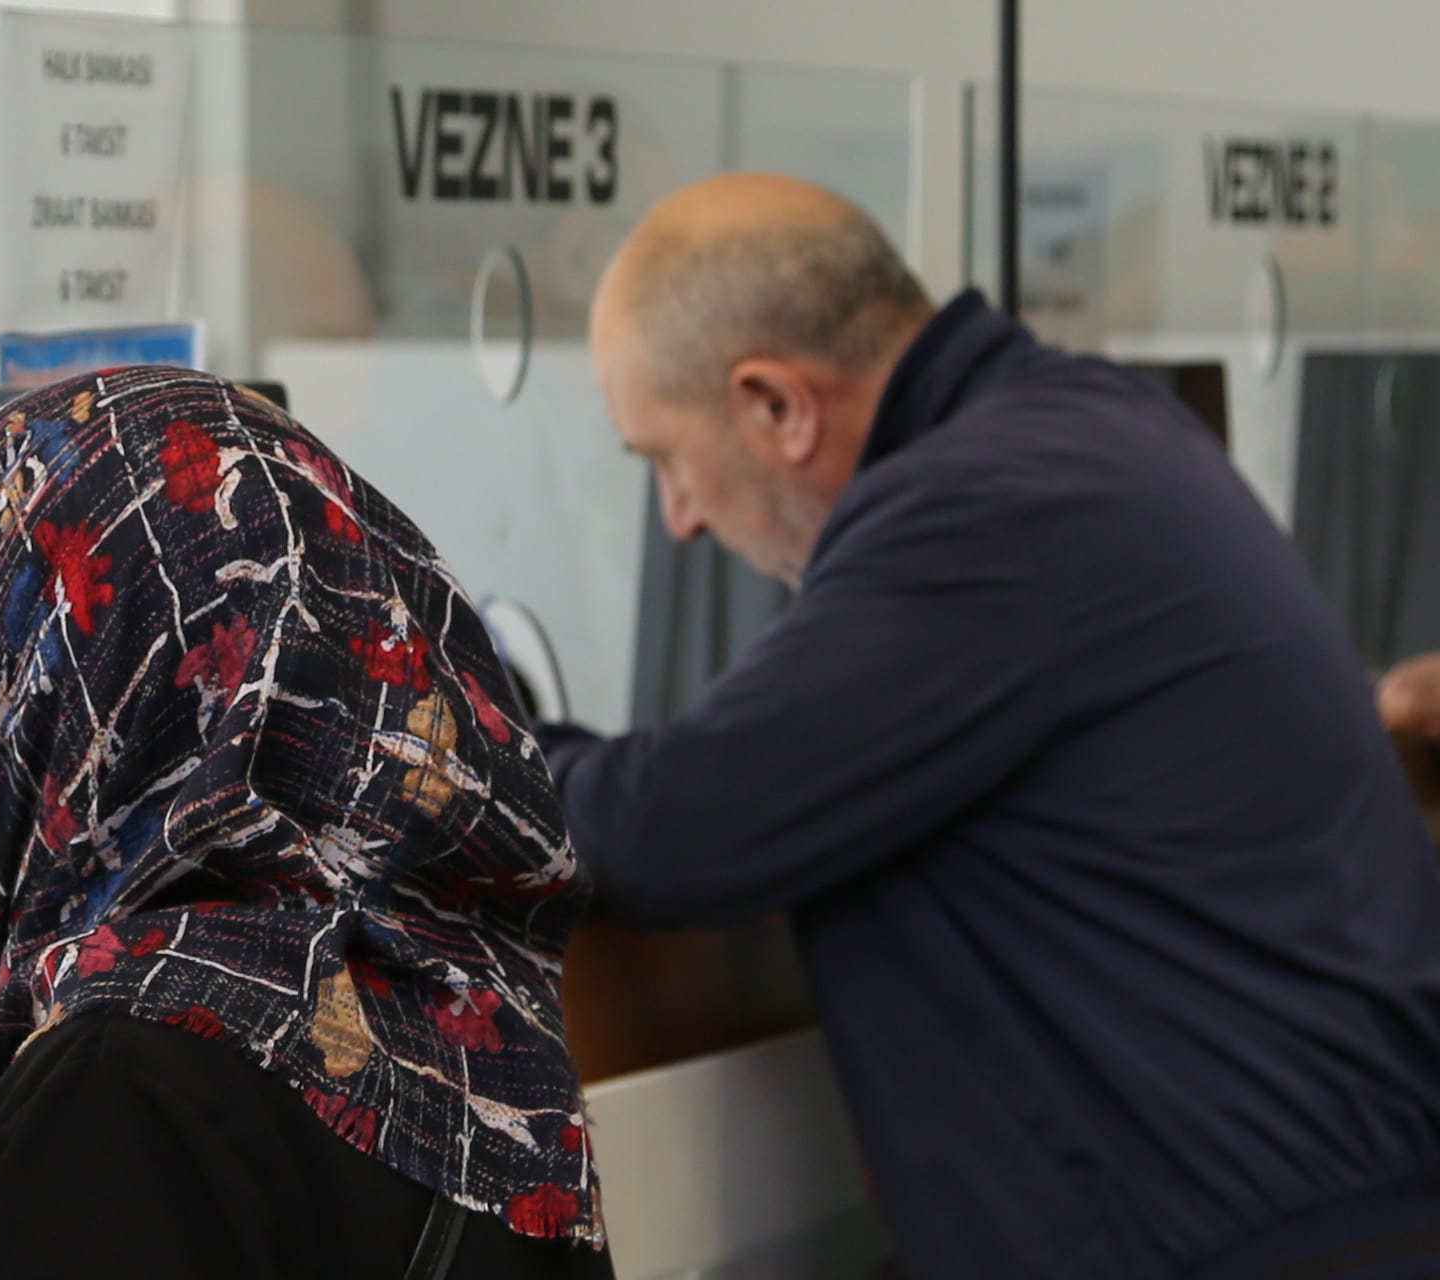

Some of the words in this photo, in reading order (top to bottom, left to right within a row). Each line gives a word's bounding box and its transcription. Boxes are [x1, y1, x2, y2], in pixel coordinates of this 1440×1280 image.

[389, 83, 574, 203] VEZNE
[585, 94, 620, 206] 3
[1202, 136, 1312, 227] VEZNE
